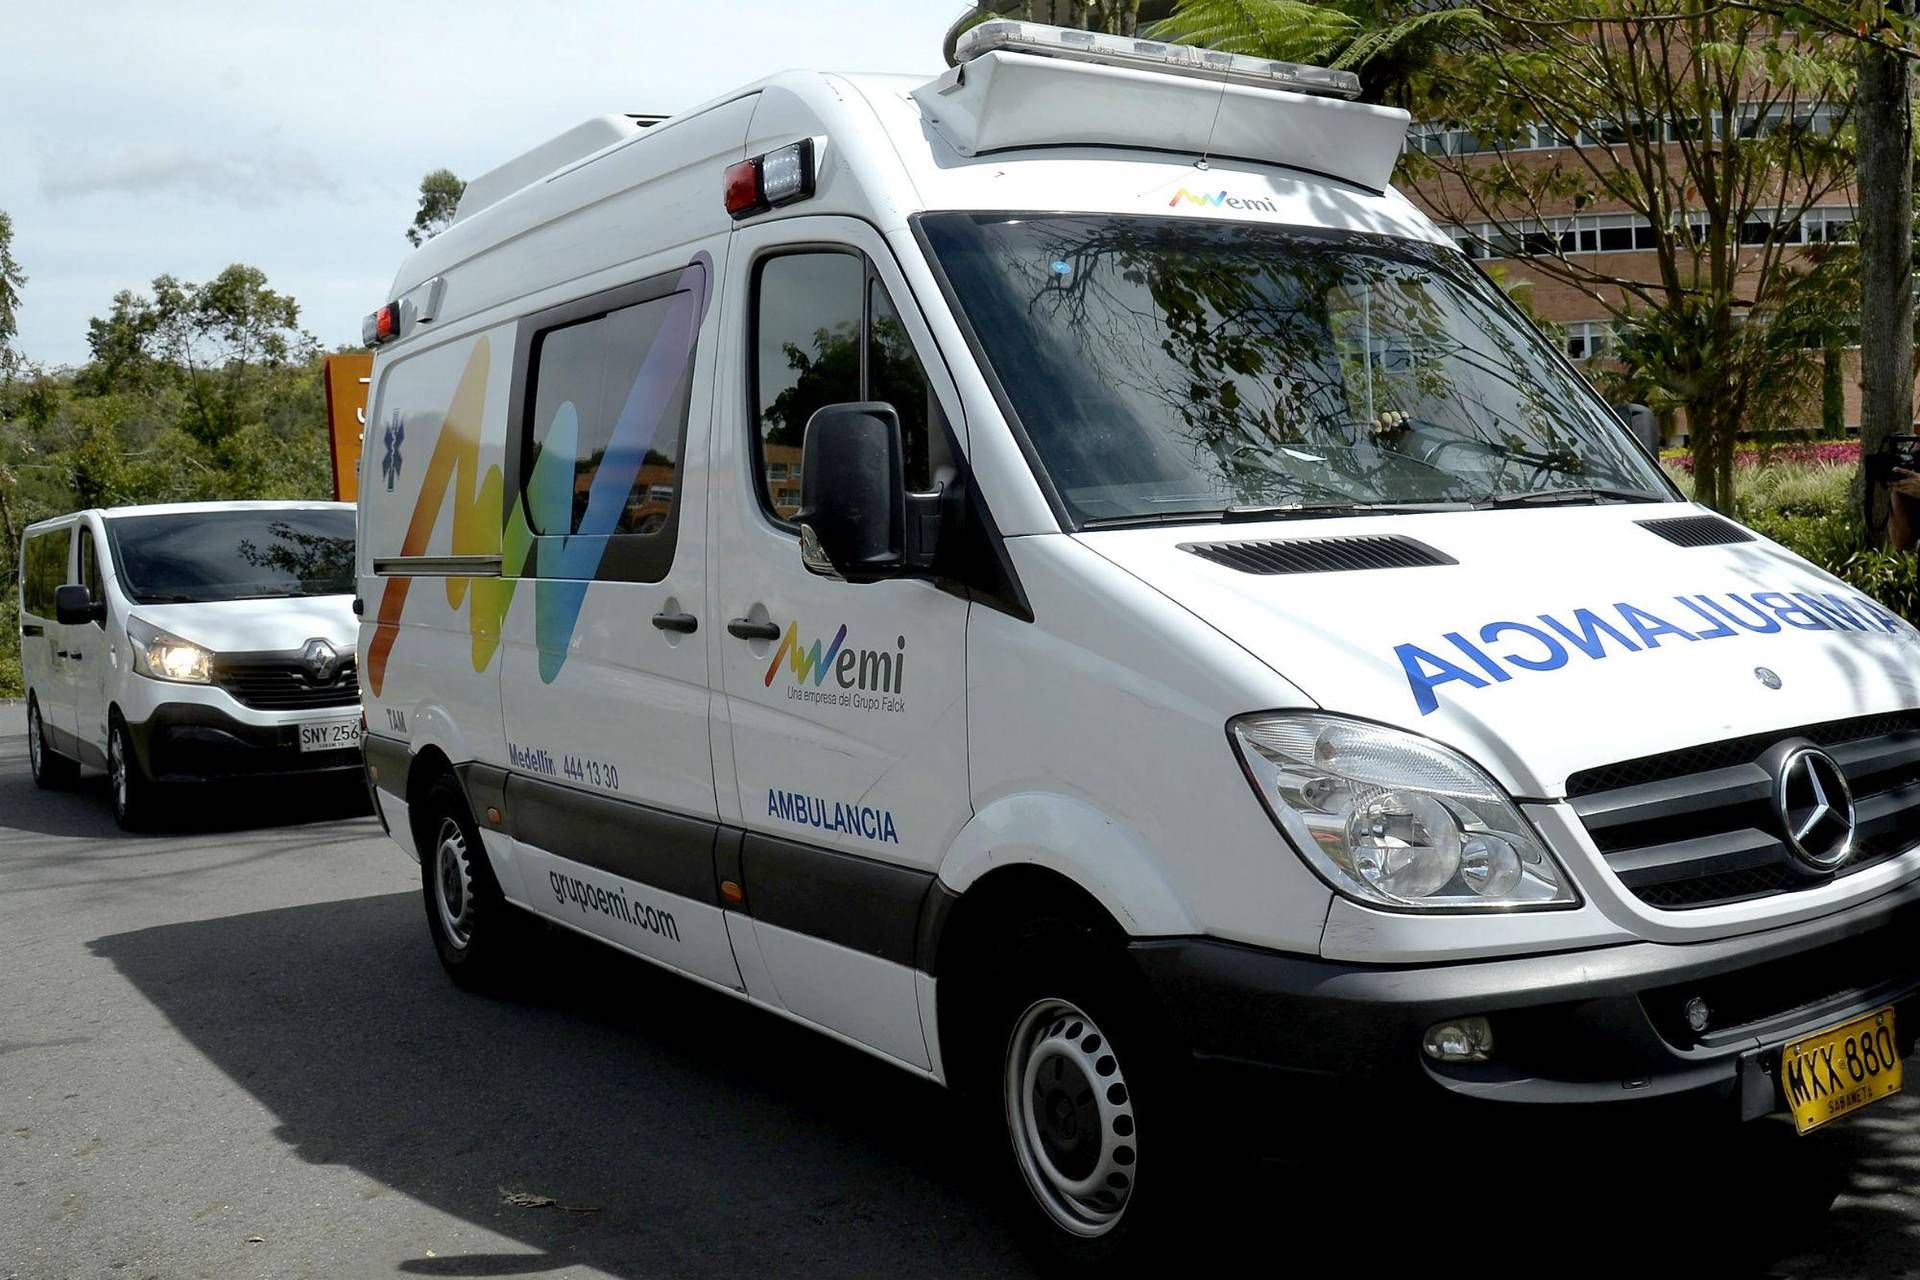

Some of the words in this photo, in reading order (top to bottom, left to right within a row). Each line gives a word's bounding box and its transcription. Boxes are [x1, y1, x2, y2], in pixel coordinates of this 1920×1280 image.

[1226, 197, 1278, 212] emi
[836, 635, 906, 694] emi
[386, 708, 407, 733] TAM
[787, 685, 802, 700] Una
[804, 690, 837, 706] empresa
[839, 692, 851, 707] del
[853, 693, 880, 713] Grupo
[881, 696, 905, 713] Falck
[302, 727, 328, 744] SNY
[333, 724, 359, 741] 256
[508, 742, 557, 777] Medellín
[563, 755, 584, 781] 444
[586, 759, 601, 786] 13
[603, 763, 619, 790] 30
[768, 788, 899, 844] AMBULANCIA
[549, 870, 681, 943] grupoemi.com
[1787, 1043, 1844, 1107] MXX
[1845, 1025, 1895, 1083] 880
